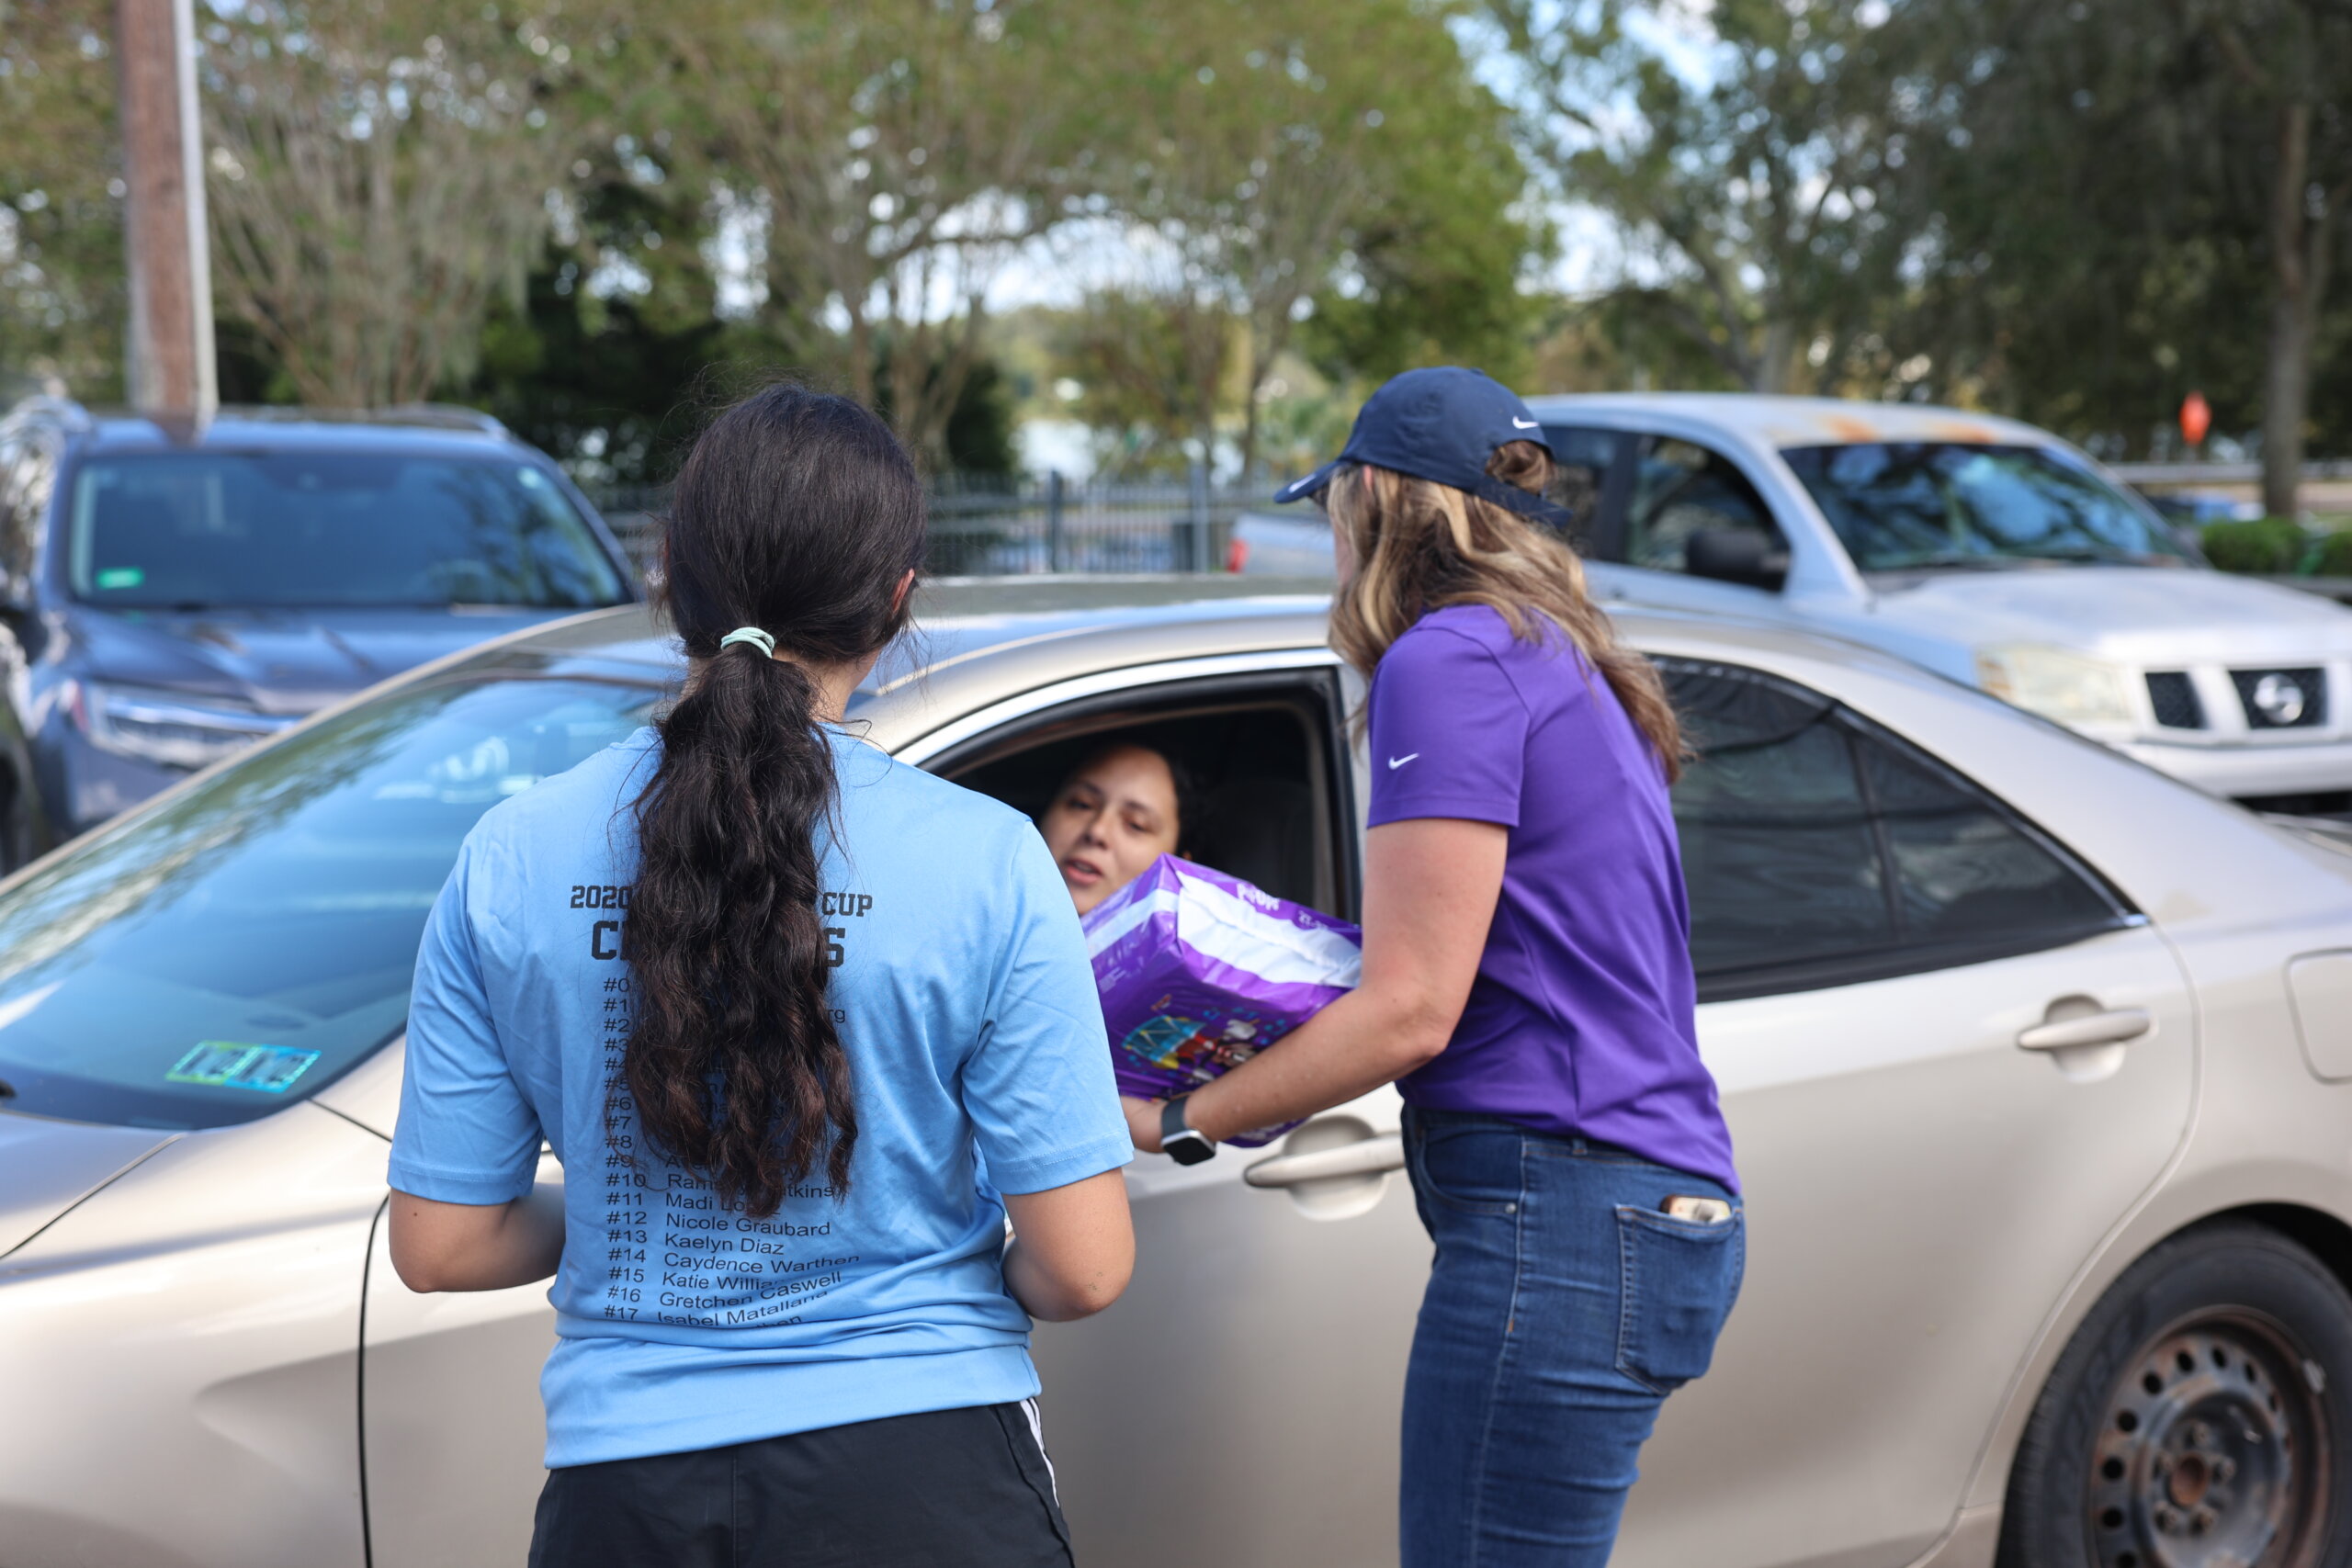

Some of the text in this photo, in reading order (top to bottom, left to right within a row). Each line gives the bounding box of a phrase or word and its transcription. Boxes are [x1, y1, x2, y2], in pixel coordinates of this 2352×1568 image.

[822, 892, 873, 917] CUP
[604, 978, 629, 992] #0
[604, 998, 628, 1012] #1
[604, 1019, 630, 1032] #2
[604, 1038, 629, 1052] #3
[605, 1077, 629, 1090] #5
[605, 1097, 631, 1111] #6
[605, 1116, 632, 1130] #7
[605, 1135, 632, 1149] #8
[606, 1155, 633, 1168] #9
[606, 1174, 646, 1187] #10
[607, 1193, 642, 1206] #11
[666, 1191, 713, 1210] Madi
[607, 1212, 831, 1236] #12 Nicole Graubard
[608, 1230, 785, 1255] #13 Kaelyn Diaz
[608, 1248, 860, 1273] #14 Caydence Warthen
[609, 1267, 644, 1283] #15
[662, 1272, 709, 1290] Katie
[608, 1271, 842, 1307] #16 Gretchen Caswell
[605, 1305, 638, 1321] #17
[658, 1311, 718, 1326] Isabel
[728, 1291, 828, 1325] Matallana
